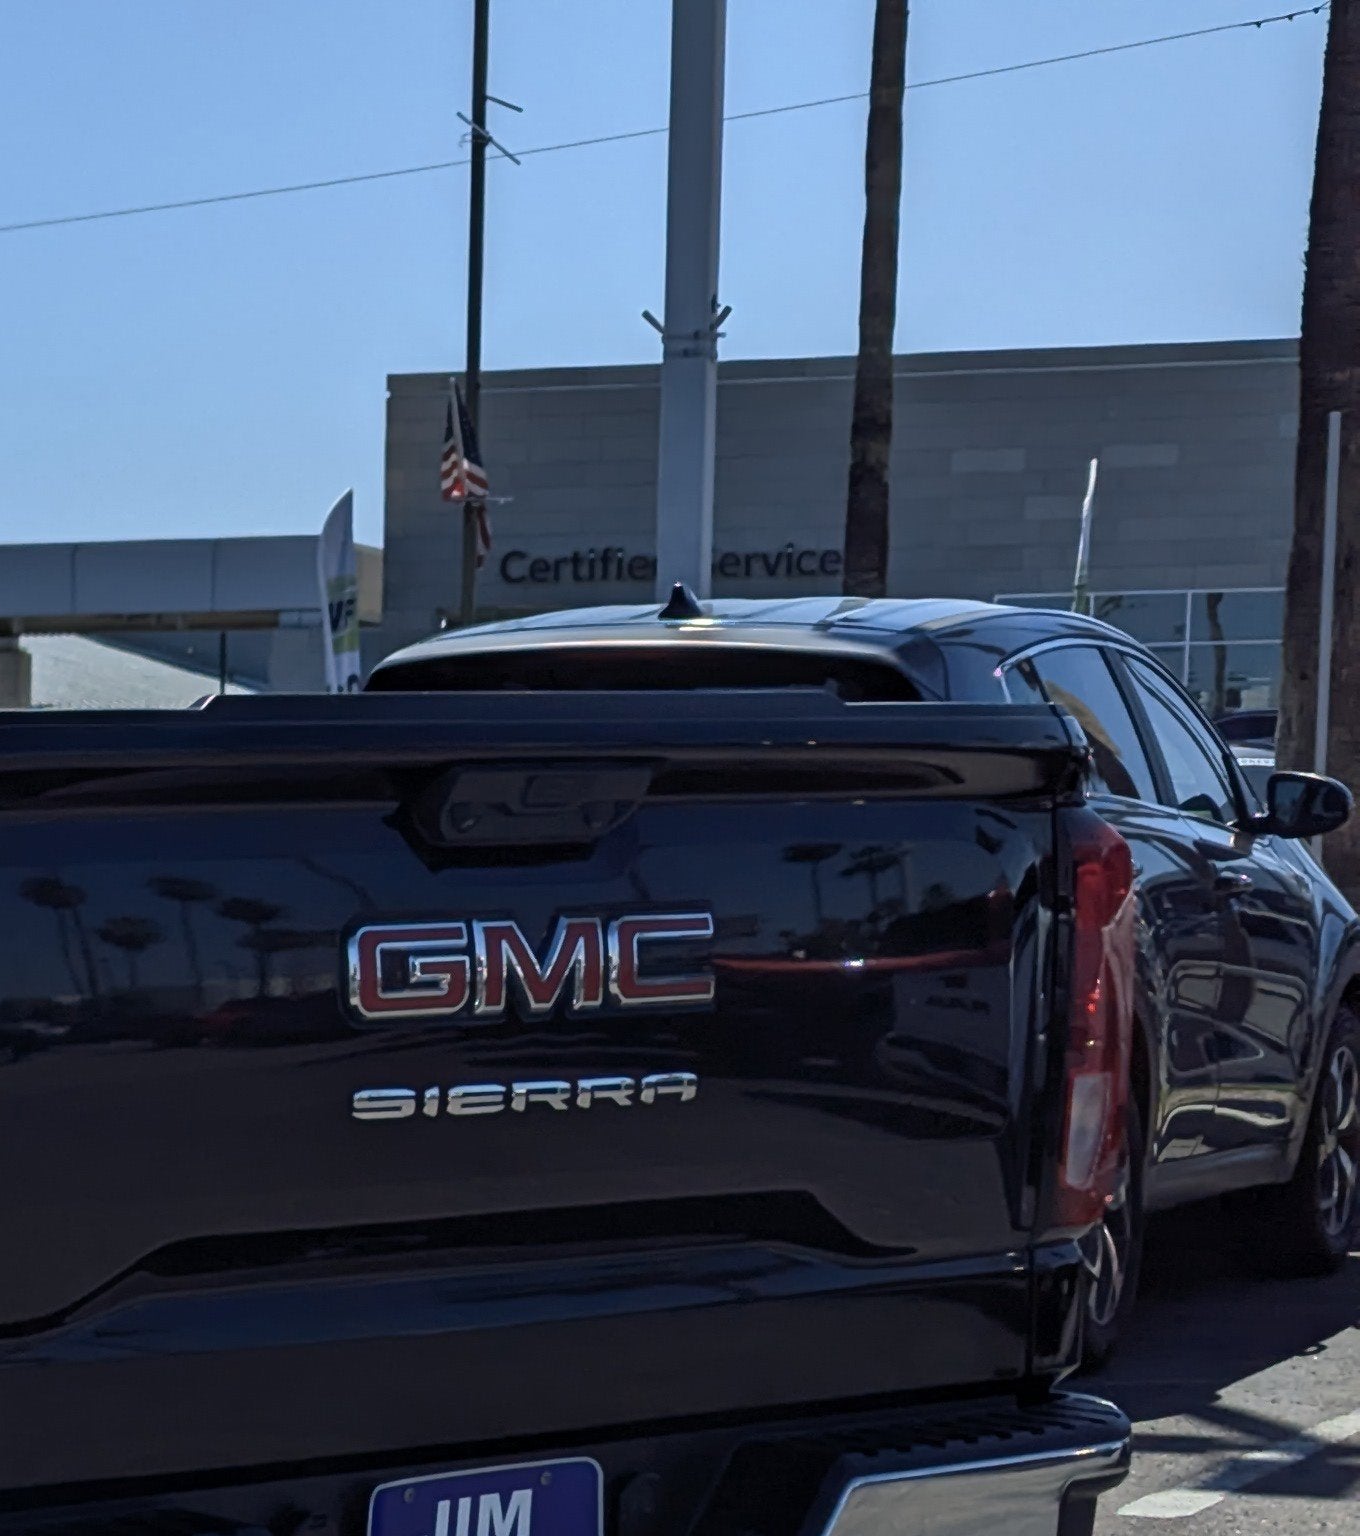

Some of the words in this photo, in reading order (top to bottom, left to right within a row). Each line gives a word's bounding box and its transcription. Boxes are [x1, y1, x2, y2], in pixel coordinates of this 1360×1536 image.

[499, 548, 658, 584] Certifie
[712, 542, 843, 577] ervice
[346, 911, 716, 1020] GMC
[351, 1072, 699, 1120] SIERRA
